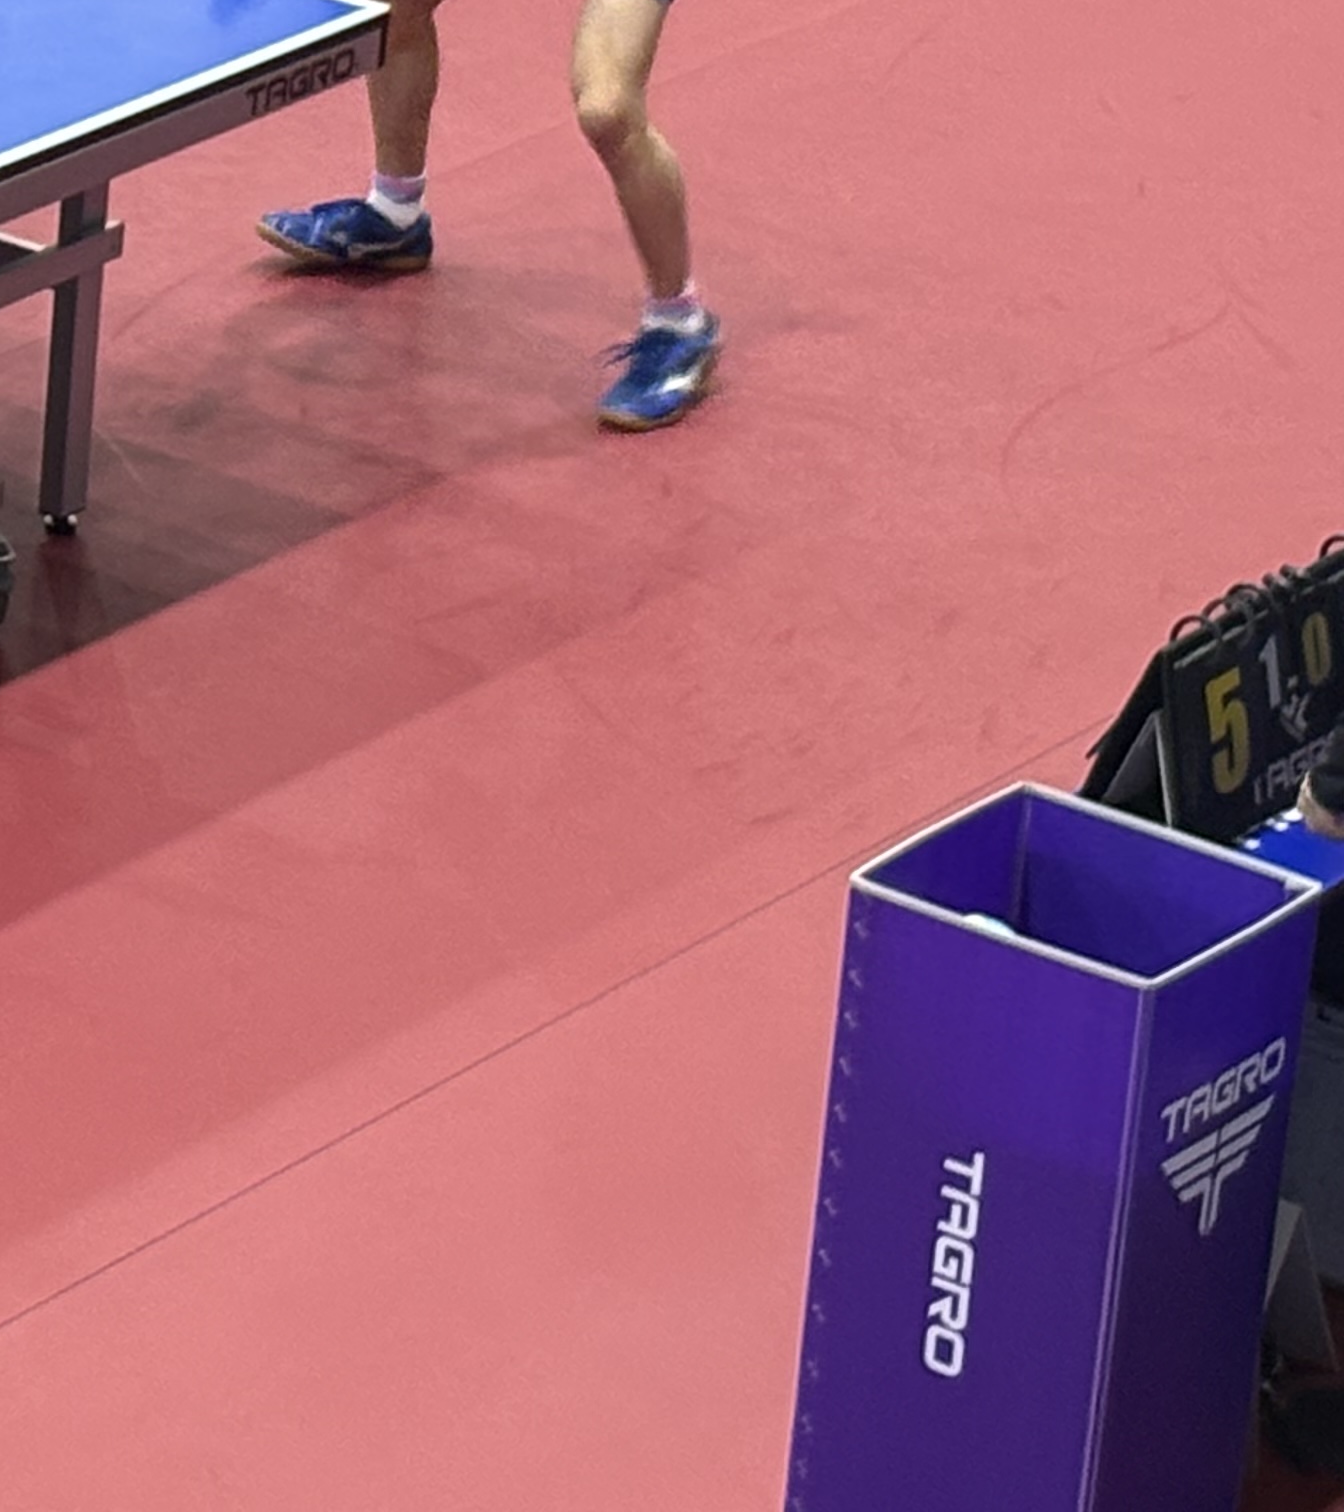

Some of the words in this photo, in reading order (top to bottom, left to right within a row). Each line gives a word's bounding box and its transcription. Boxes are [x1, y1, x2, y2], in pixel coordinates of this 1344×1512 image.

[244, 48, 355, 117] TAGRO
[1205, 666, 1250, 794] 5
[1258, 634, 1281, 709] 1
[1302, 611, 1332, 686] 0
[1160, 1036, 1286, 1143] TAGRO
[922, 1151, 985, 1378] TAGRO
